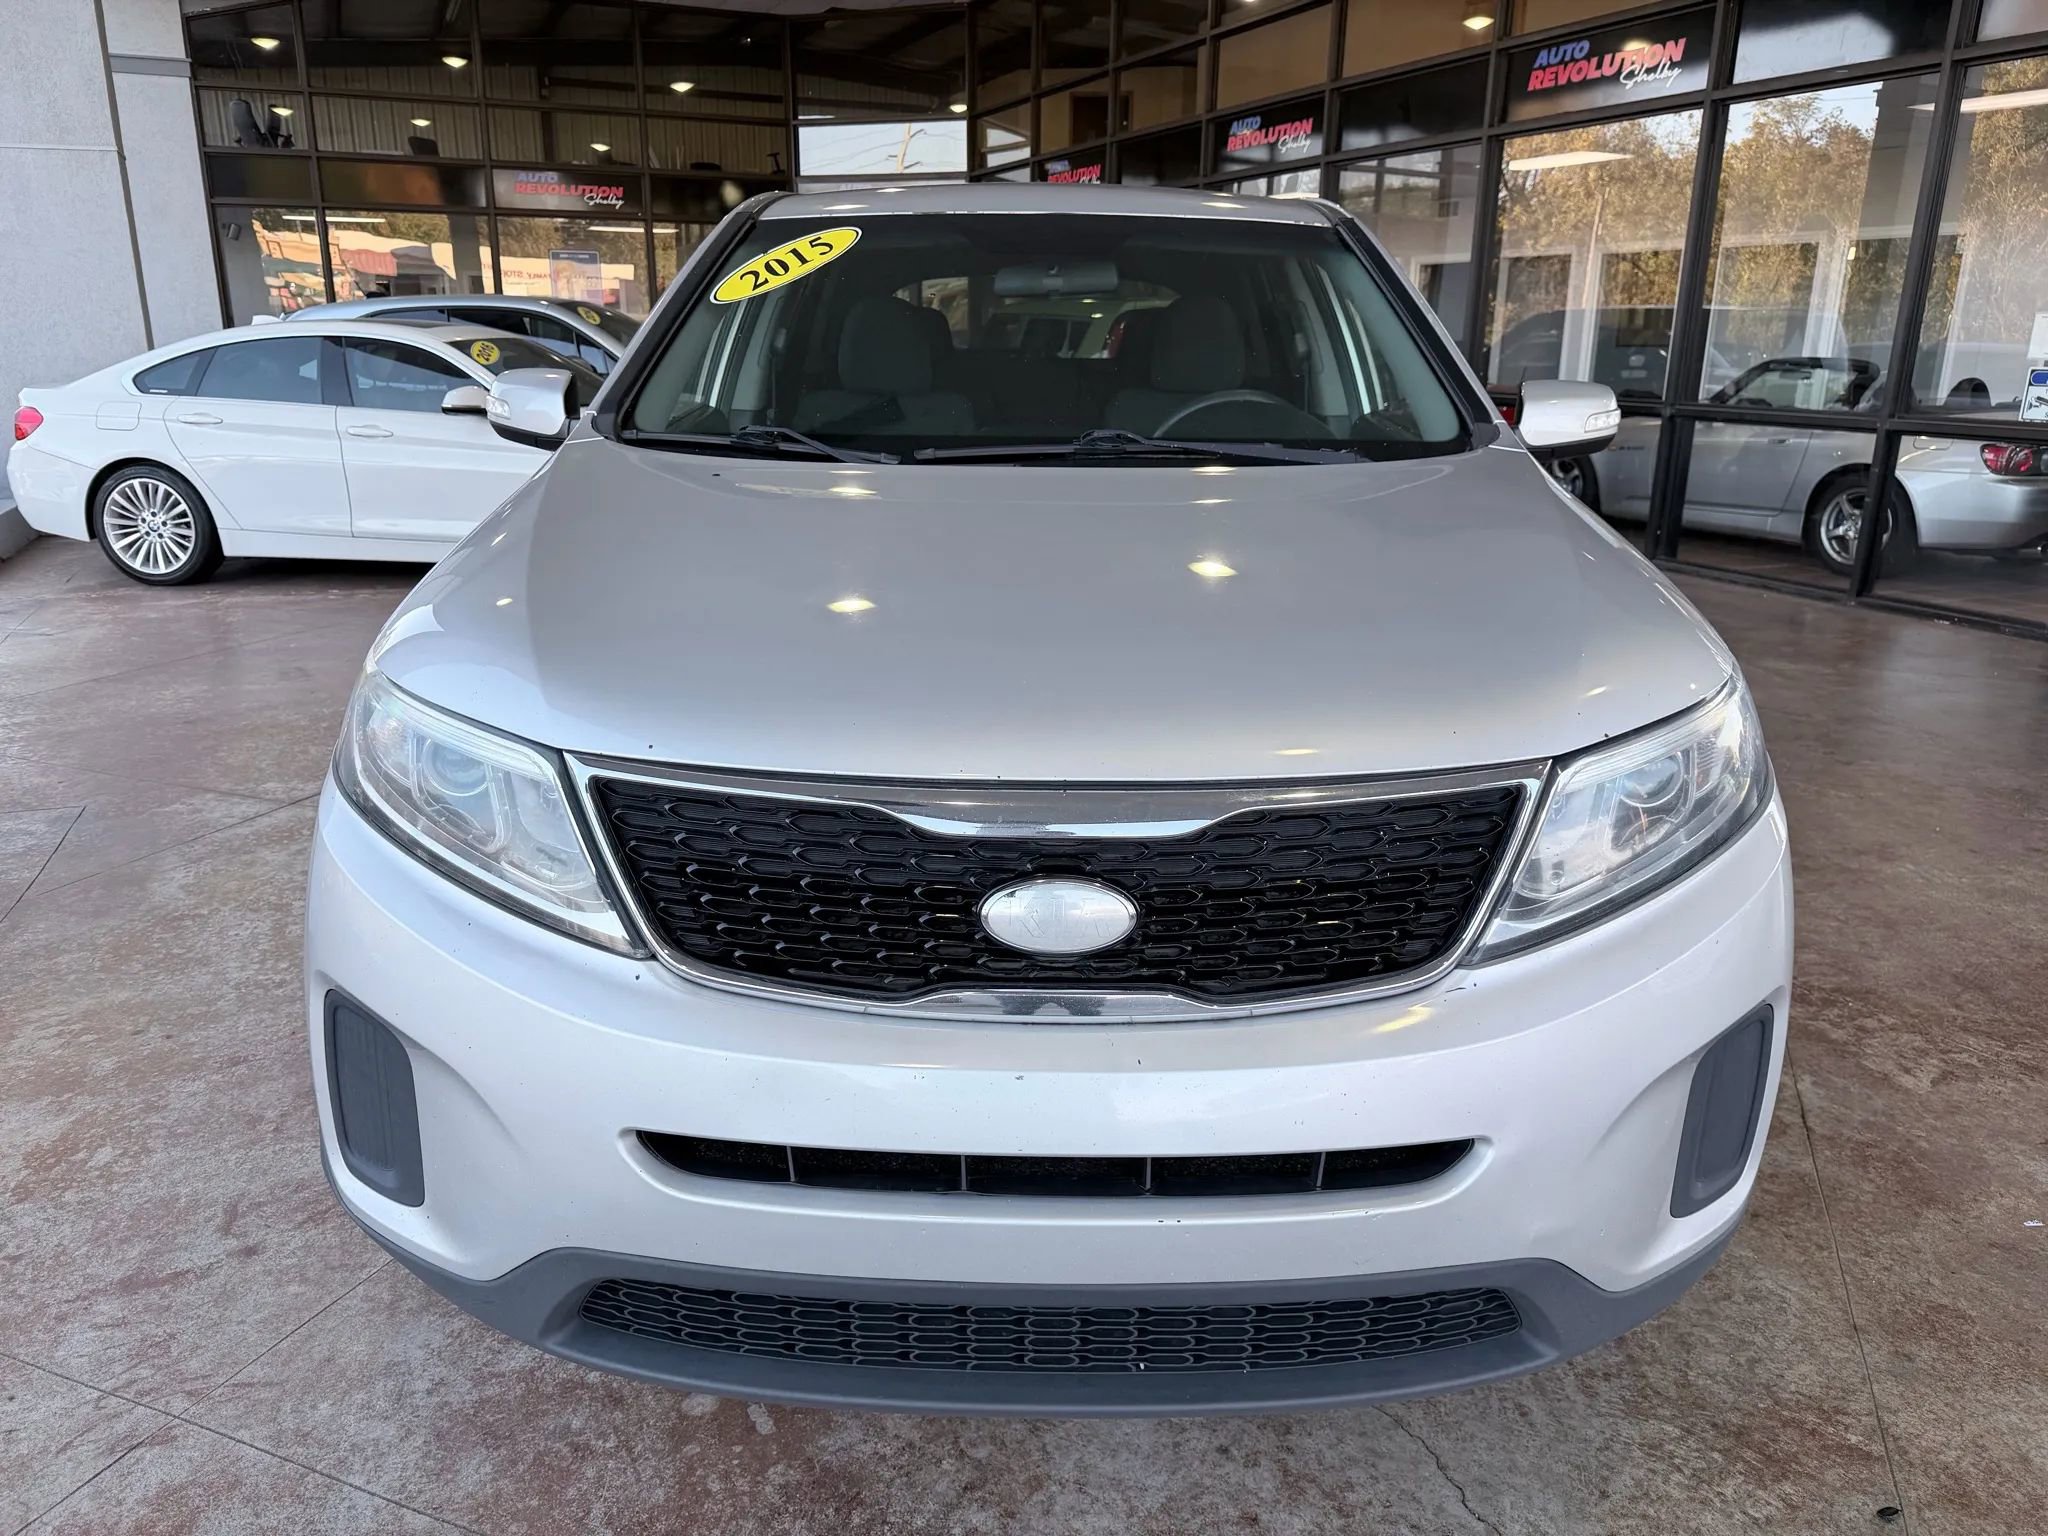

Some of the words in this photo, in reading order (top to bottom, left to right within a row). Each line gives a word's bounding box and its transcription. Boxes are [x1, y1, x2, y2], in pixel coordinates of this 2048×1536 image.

[1527, 38, 1687, 91] REVOLUTION
[1533, 40, 1590, 68] AUTO
[1620, 57, 1682, 90] Shelby
[1227, 118, 1313, 152] REVOLUTION
[1230, 116, 1261, 135] AUTO
[515, 183, 624, 197] REVOLUTION
[516, 171, 558, 182] AUTO
[583, 192, 624, 209] Shelby
[739, 236, 834, 291] 2015
